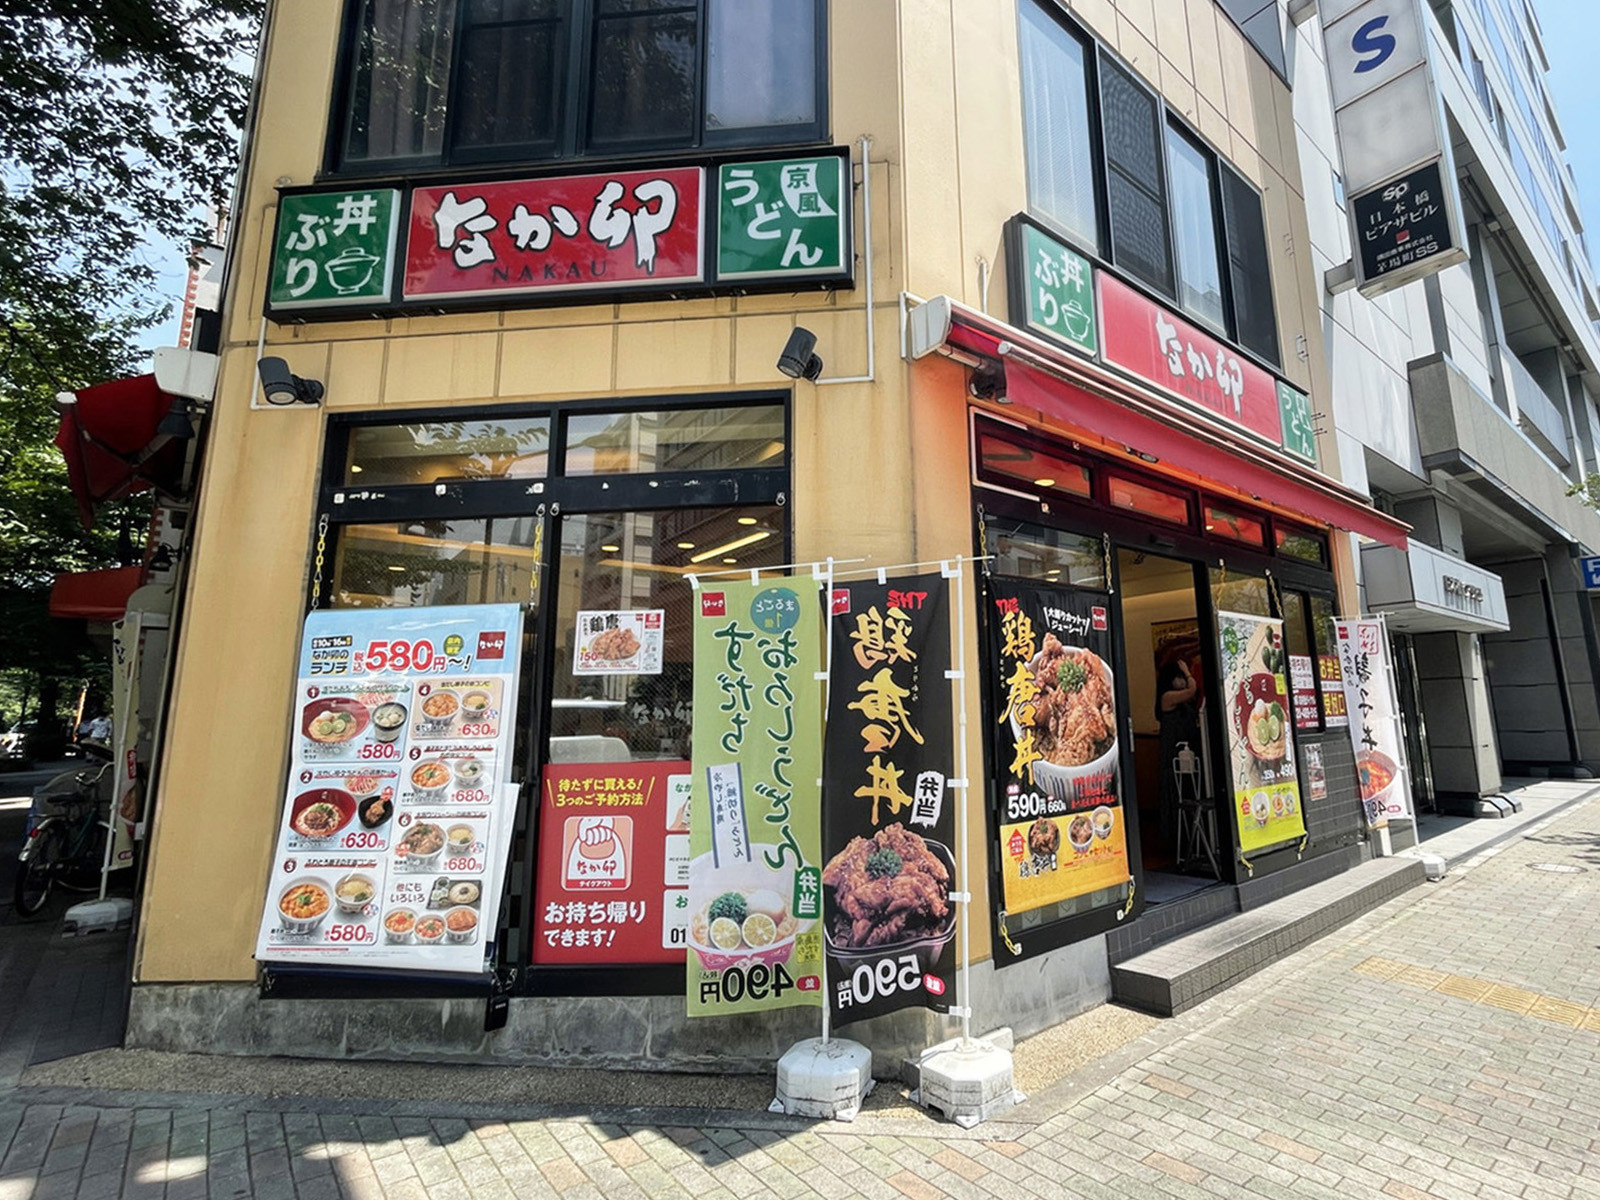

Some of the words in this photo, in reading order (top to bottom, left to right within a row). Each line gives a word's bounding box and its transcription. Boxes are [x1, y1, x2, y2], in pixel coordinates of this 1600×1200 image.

[1352, 15, 1396, 73] S
[786, 166, 822, 214] 京風
[434, 179, 678, 275] なか卯
[723, 169, 824, 267] うどん
[492, 261, 608, 283] NAKAU
[1155, 310, 1244, 417] なか卯
[1282, 387, 1313, 458] うどん
[311, 662, 348, 674] ランチ
[998, 610, 1044, 786] 鶏唐丼
[558, 777, 643, 792] 待たずに買える!
[556, 792, 644, 807] 3つのご予約方法
[577, 860, 617, 876] なか卯
[390, 893, 425, 903] いろいろ
[675, 895, 688, 909] お
[544, 900, 646, 924] お持ち帰り
[543, 928, 616, 947] できます!
